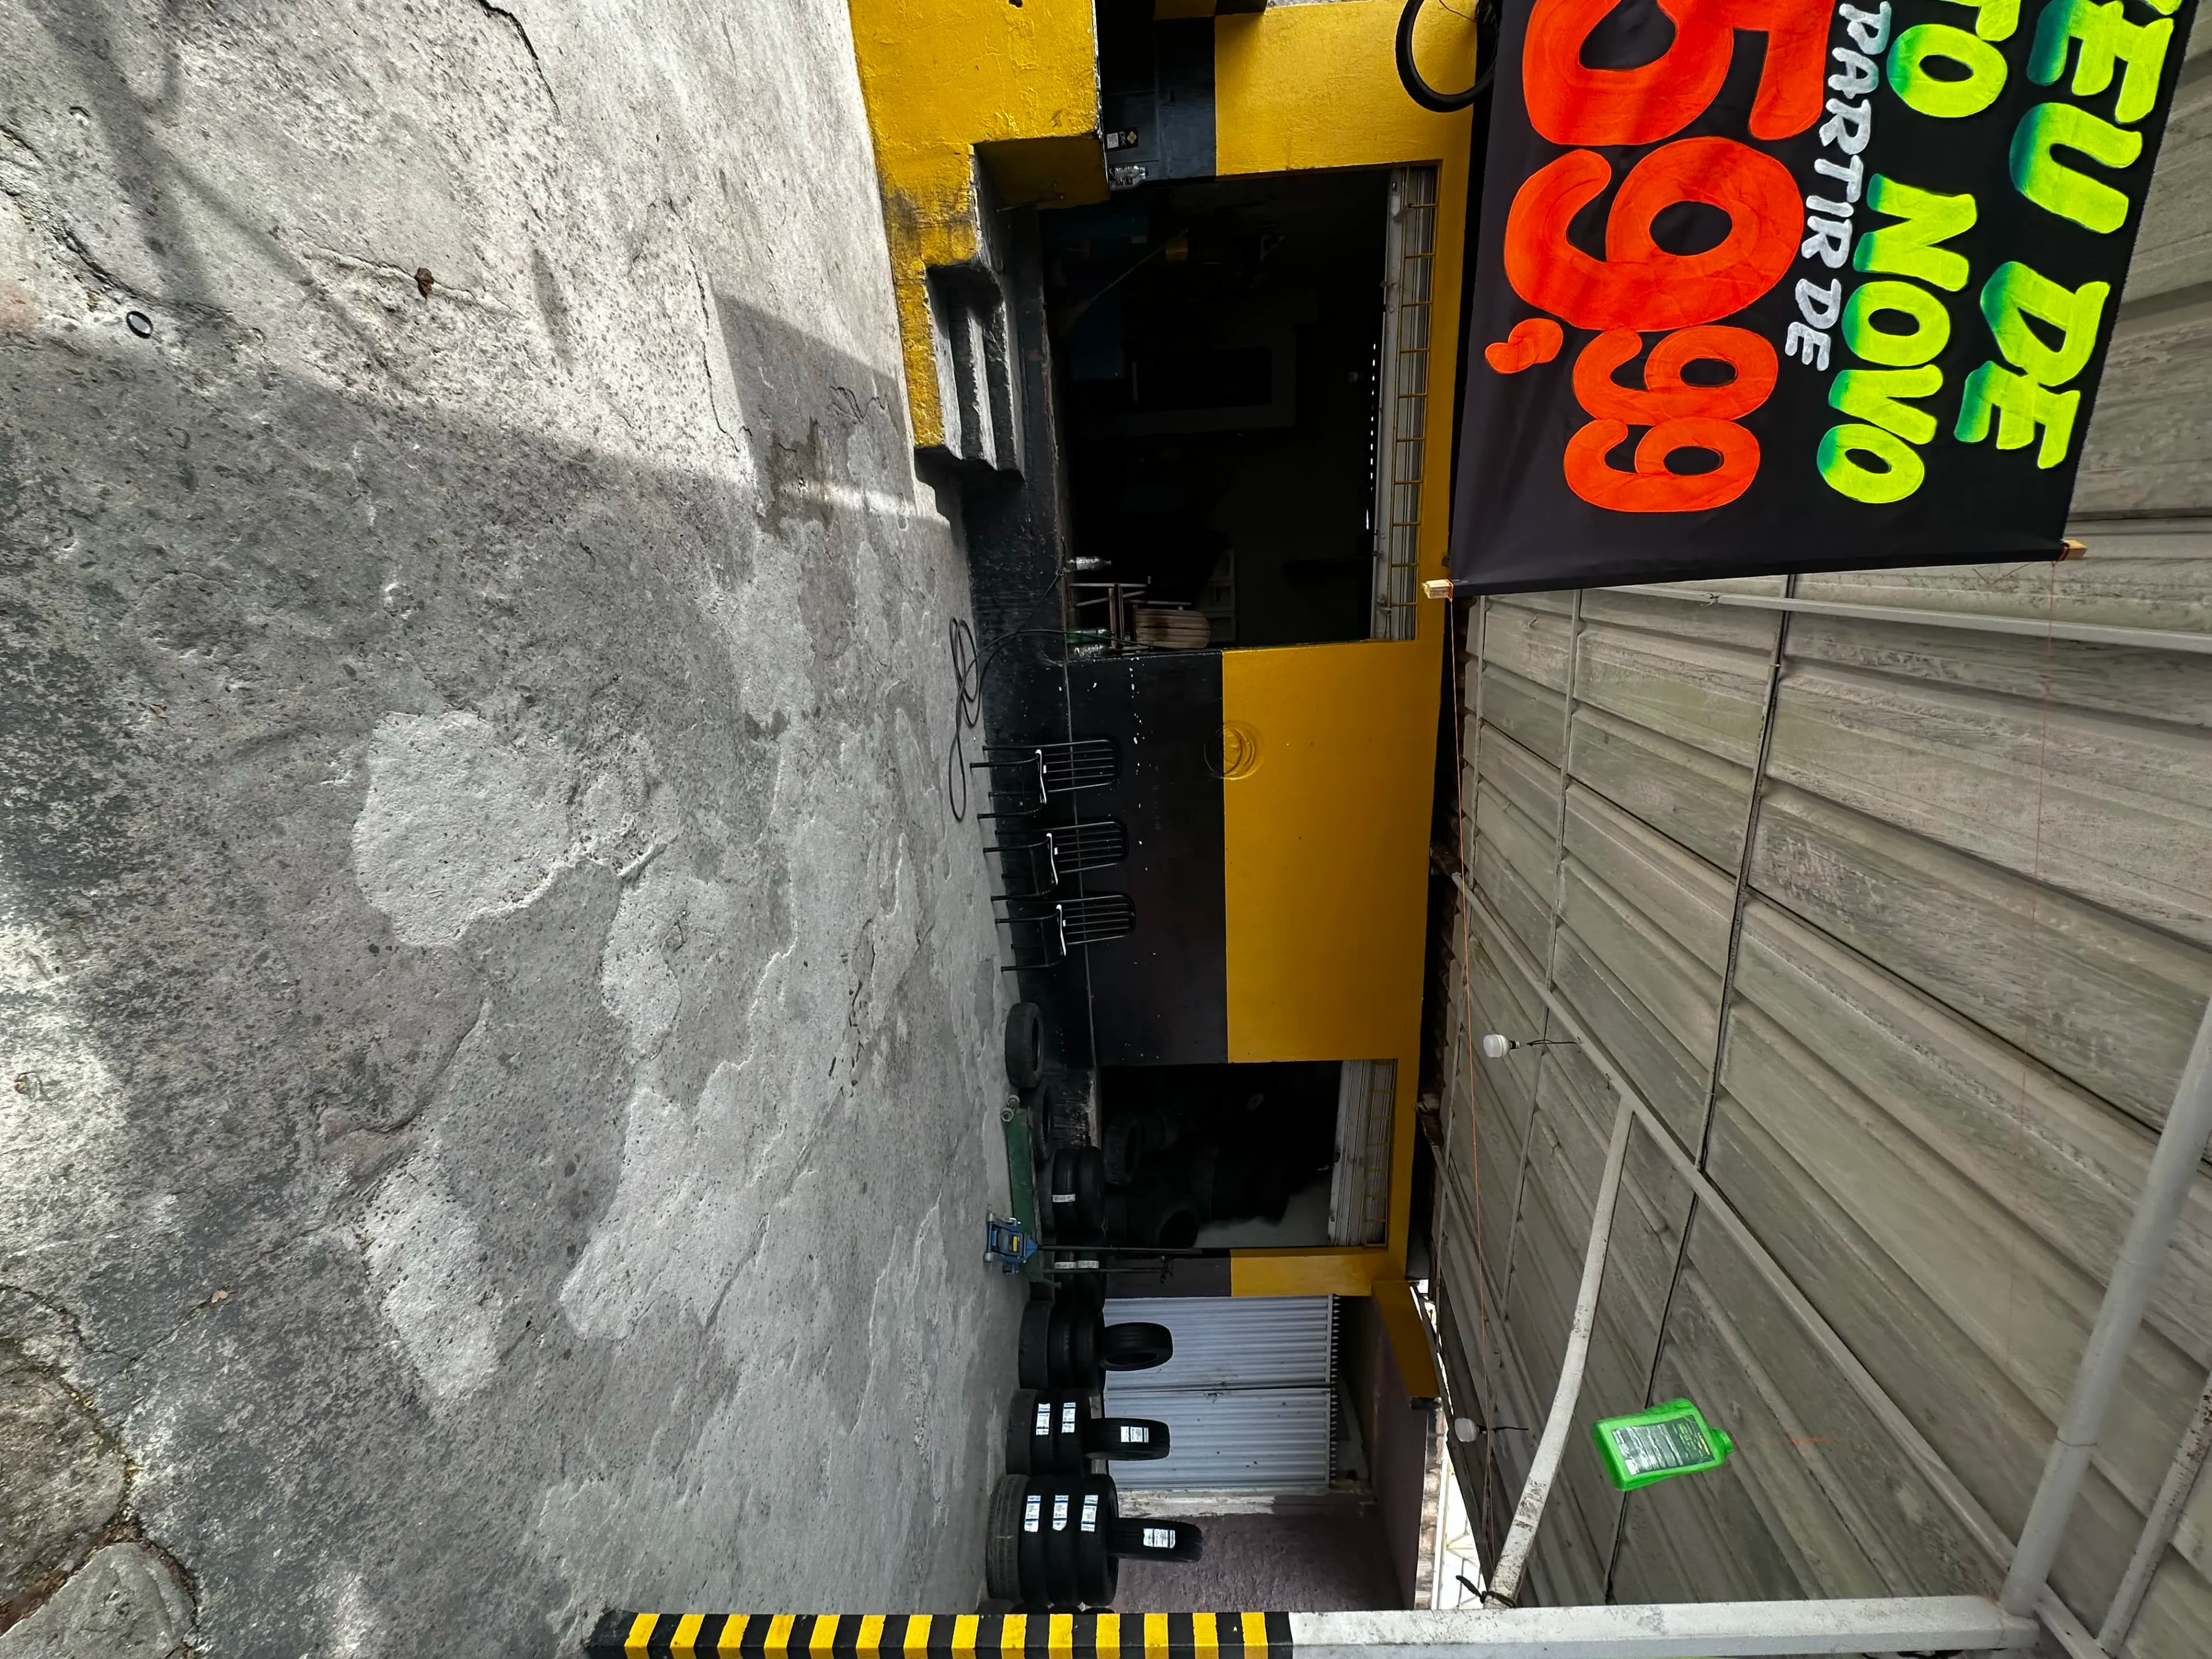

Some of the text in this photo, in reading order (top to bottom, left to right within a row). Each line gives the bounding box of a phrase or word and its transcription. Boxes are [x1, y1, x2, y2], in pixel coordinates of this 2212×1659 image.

[1785, 1, 1892, 372] PARTIR DE
[1816, 173, 1978, 505] NOVO
[1953, 0, 2183, 469] EU DE
